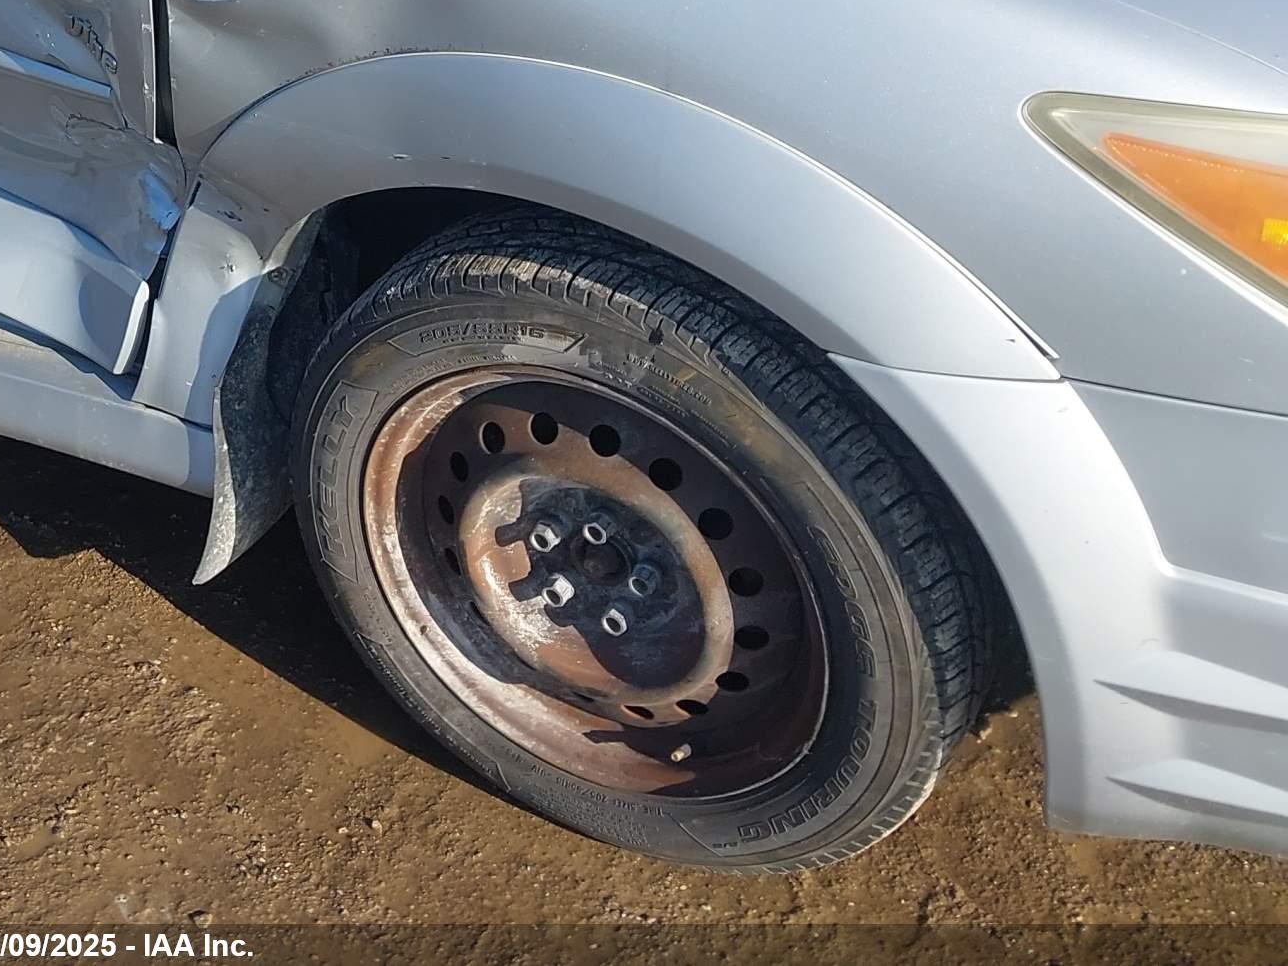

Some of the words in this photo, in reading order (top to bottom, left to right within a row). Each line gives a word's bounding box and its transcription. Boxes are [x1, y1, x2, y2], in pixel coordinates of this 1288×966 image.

[318, 393, 355, 559] KELLY
[806, 524, 878, 682] EDGE
[737, 698, 880, 842] TOURING
